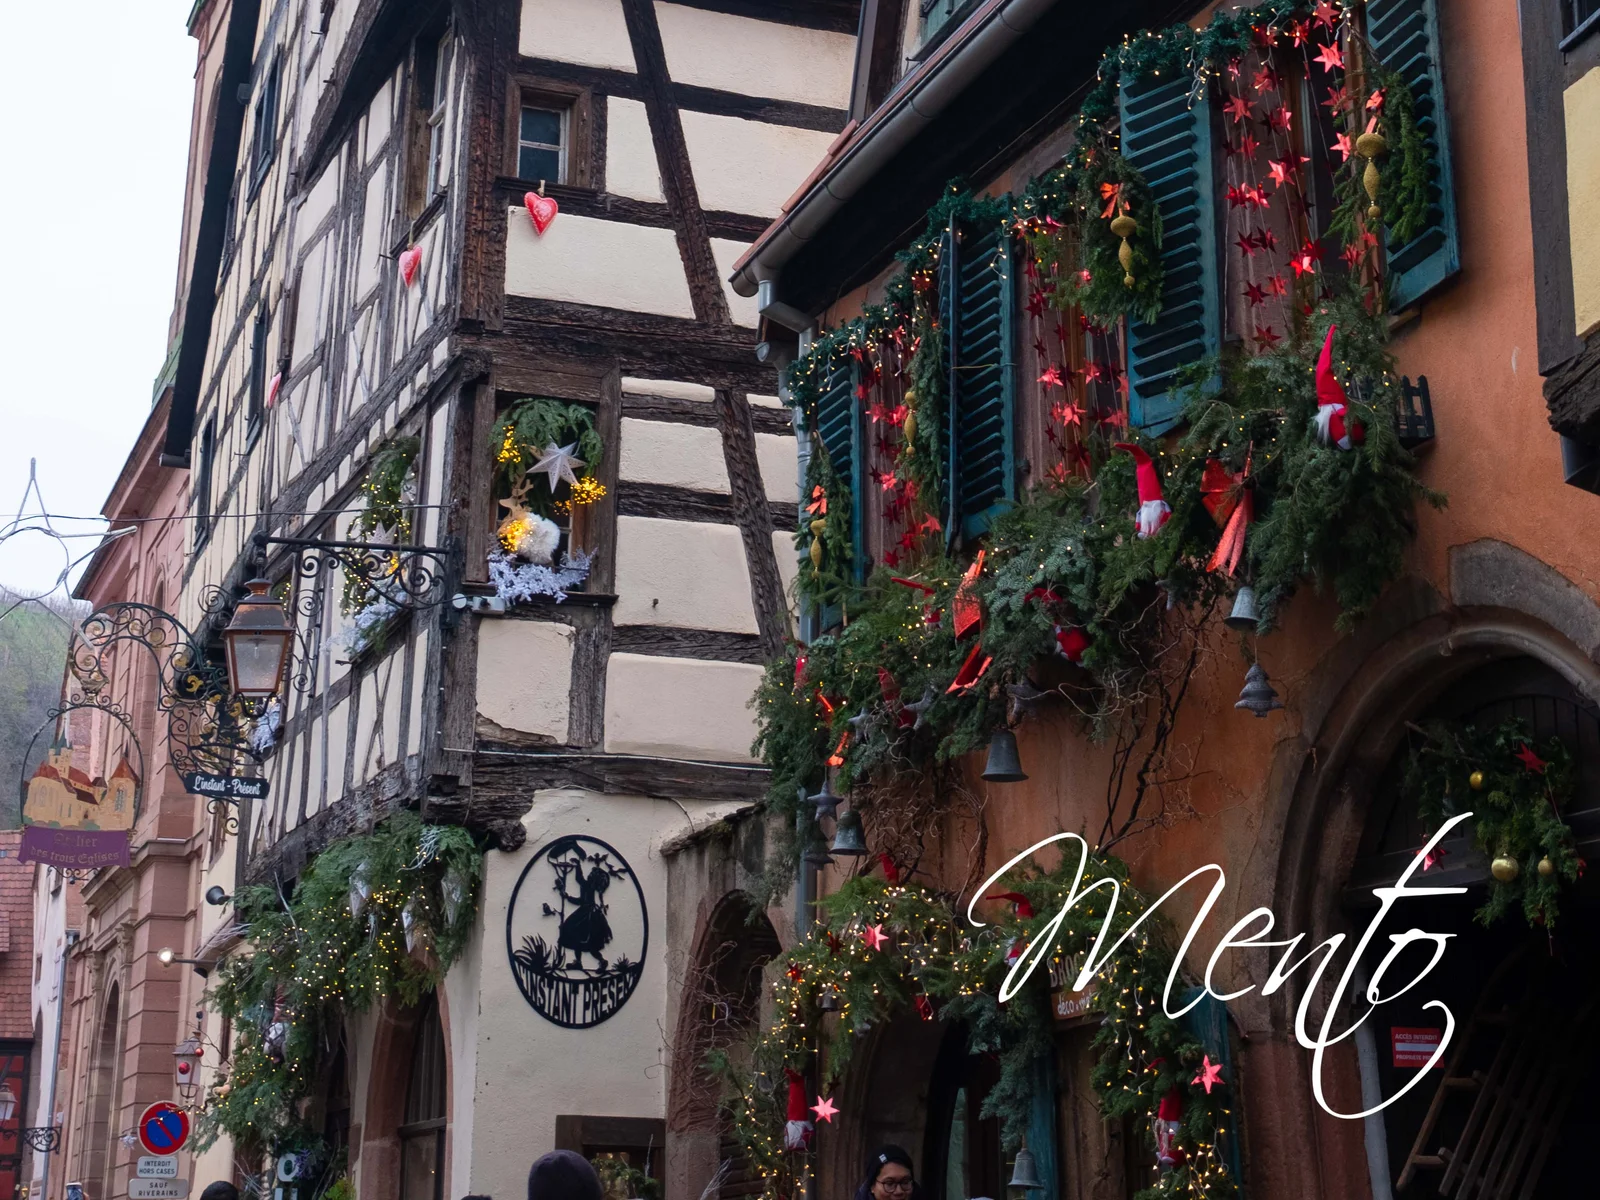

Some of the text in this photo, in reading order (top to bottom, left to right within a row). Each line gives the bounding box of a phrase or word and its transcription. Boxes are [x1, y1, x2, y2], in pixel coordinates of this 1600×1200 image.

[231, 778, 262, 795] Présent
[30, 845, 48, 858] des
[50, 851, 75, 864] trois
